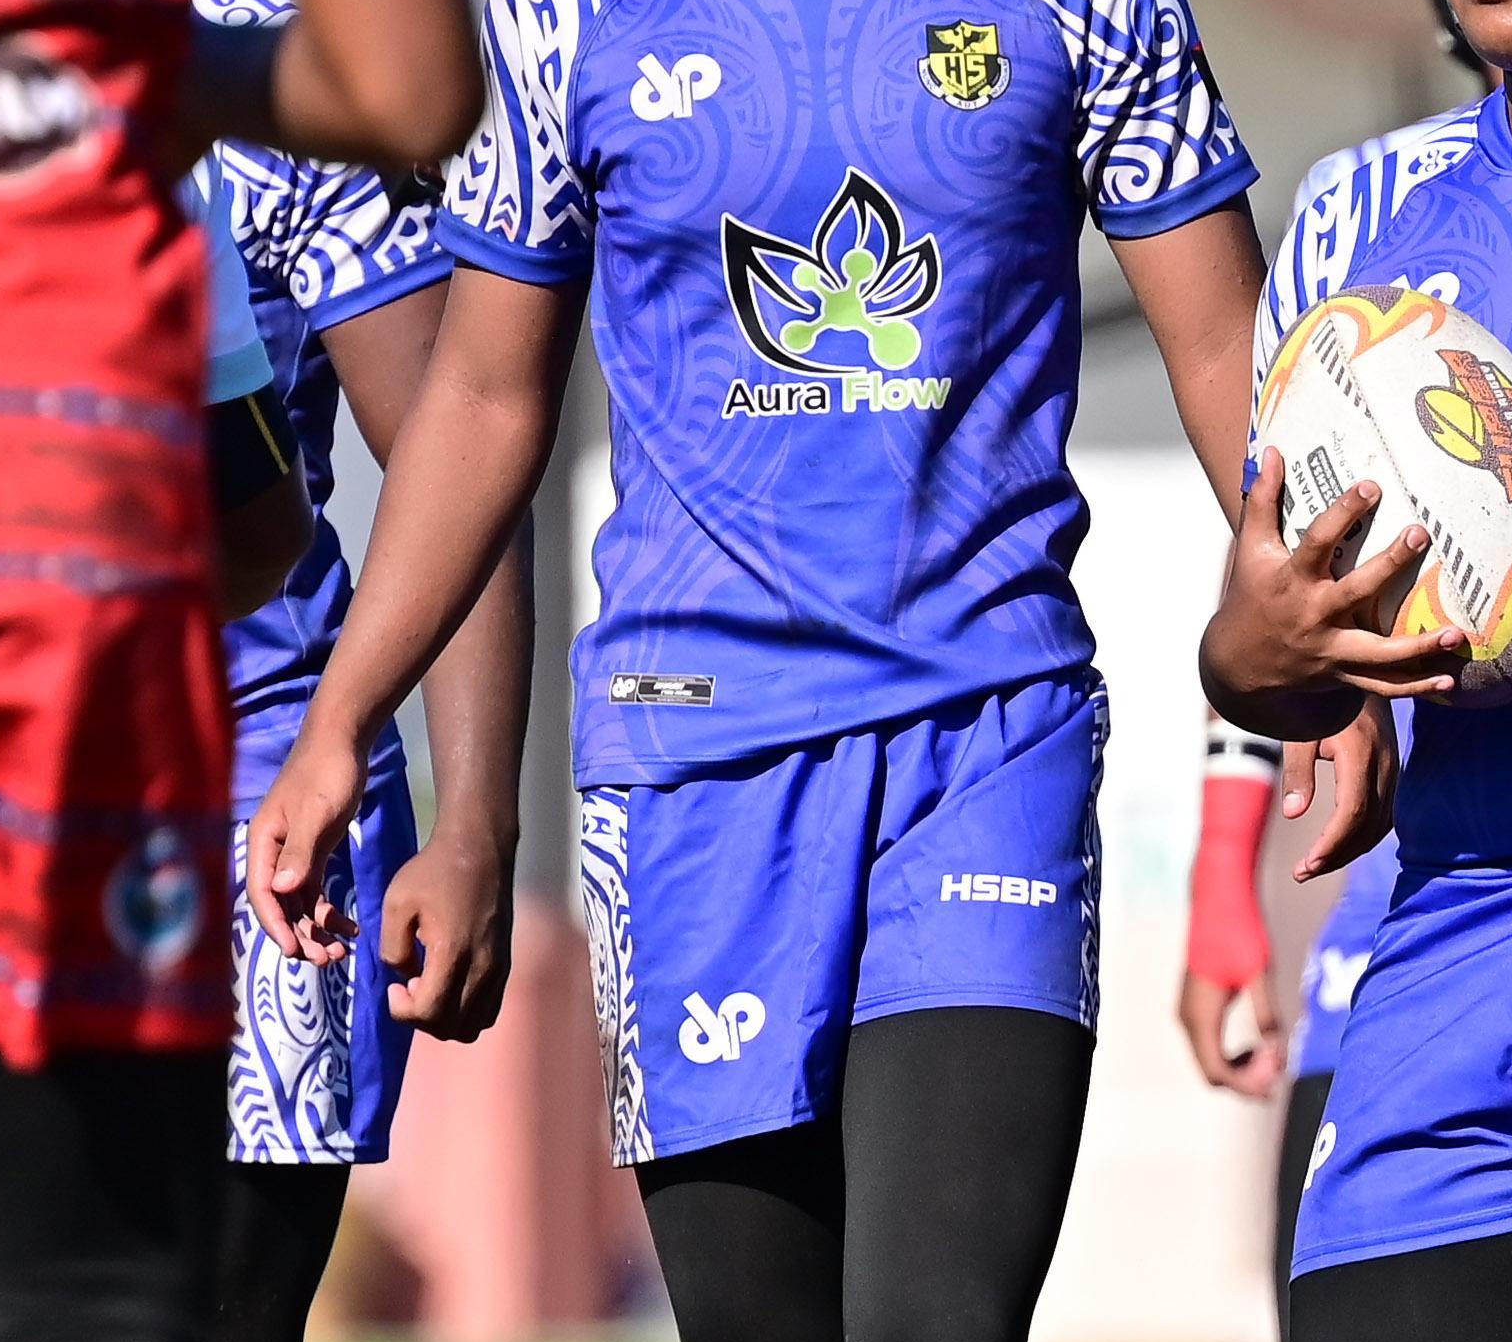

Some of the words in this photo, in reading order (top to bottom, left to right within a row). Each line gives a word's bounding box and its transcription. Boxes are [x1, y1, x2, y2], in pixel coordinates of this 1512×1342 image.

[721, 376, 829, 419] Aura
[841, 373, 952, 415] Flow
[1290, 459, 1320, 516] PIANS
[938, 872, 1058, 908] HSBP
